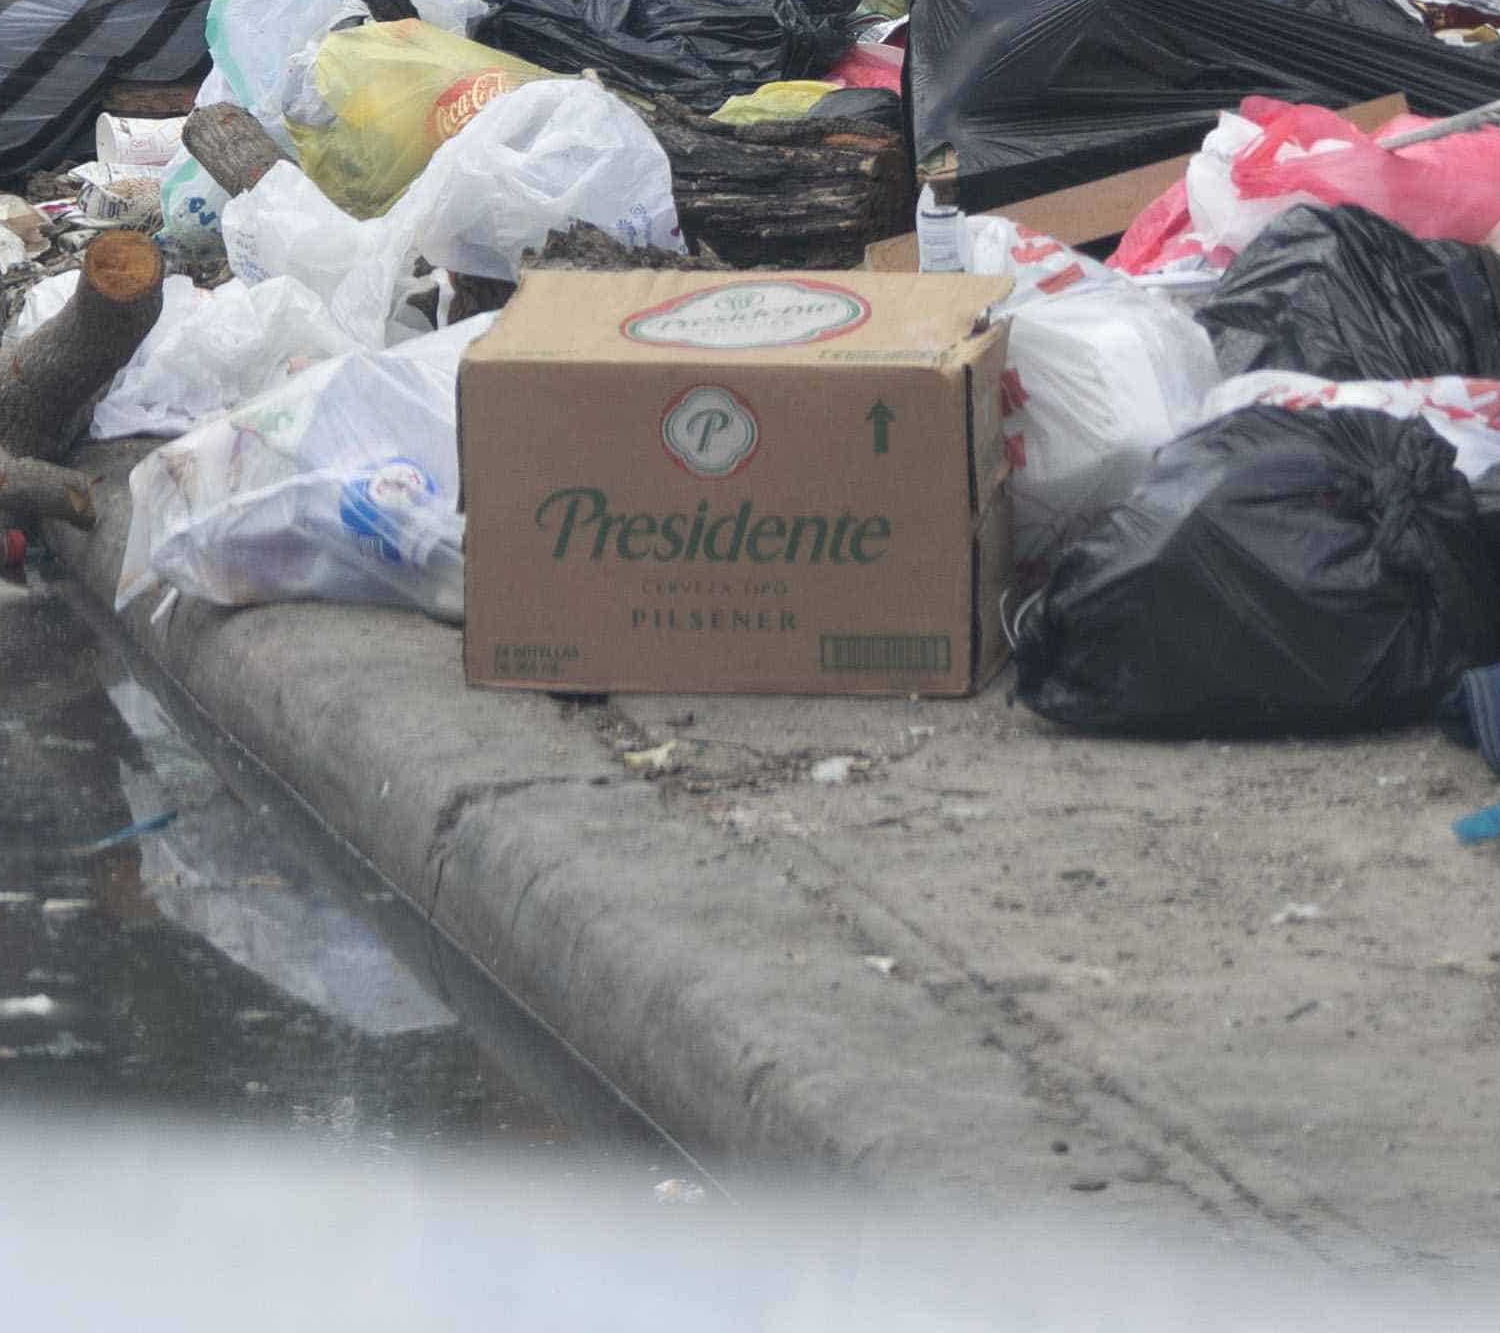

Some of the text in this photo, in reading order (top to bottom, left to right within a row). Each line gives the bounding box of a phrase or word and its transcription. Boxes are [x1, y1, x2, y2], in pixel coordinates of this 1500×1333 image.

[686, 408, 733, 453] P
[535, 486, 892, 565] Presidente
[641, 579, 734, 597] CERVEZA
[631, 608, 798, 631] PILSENER
